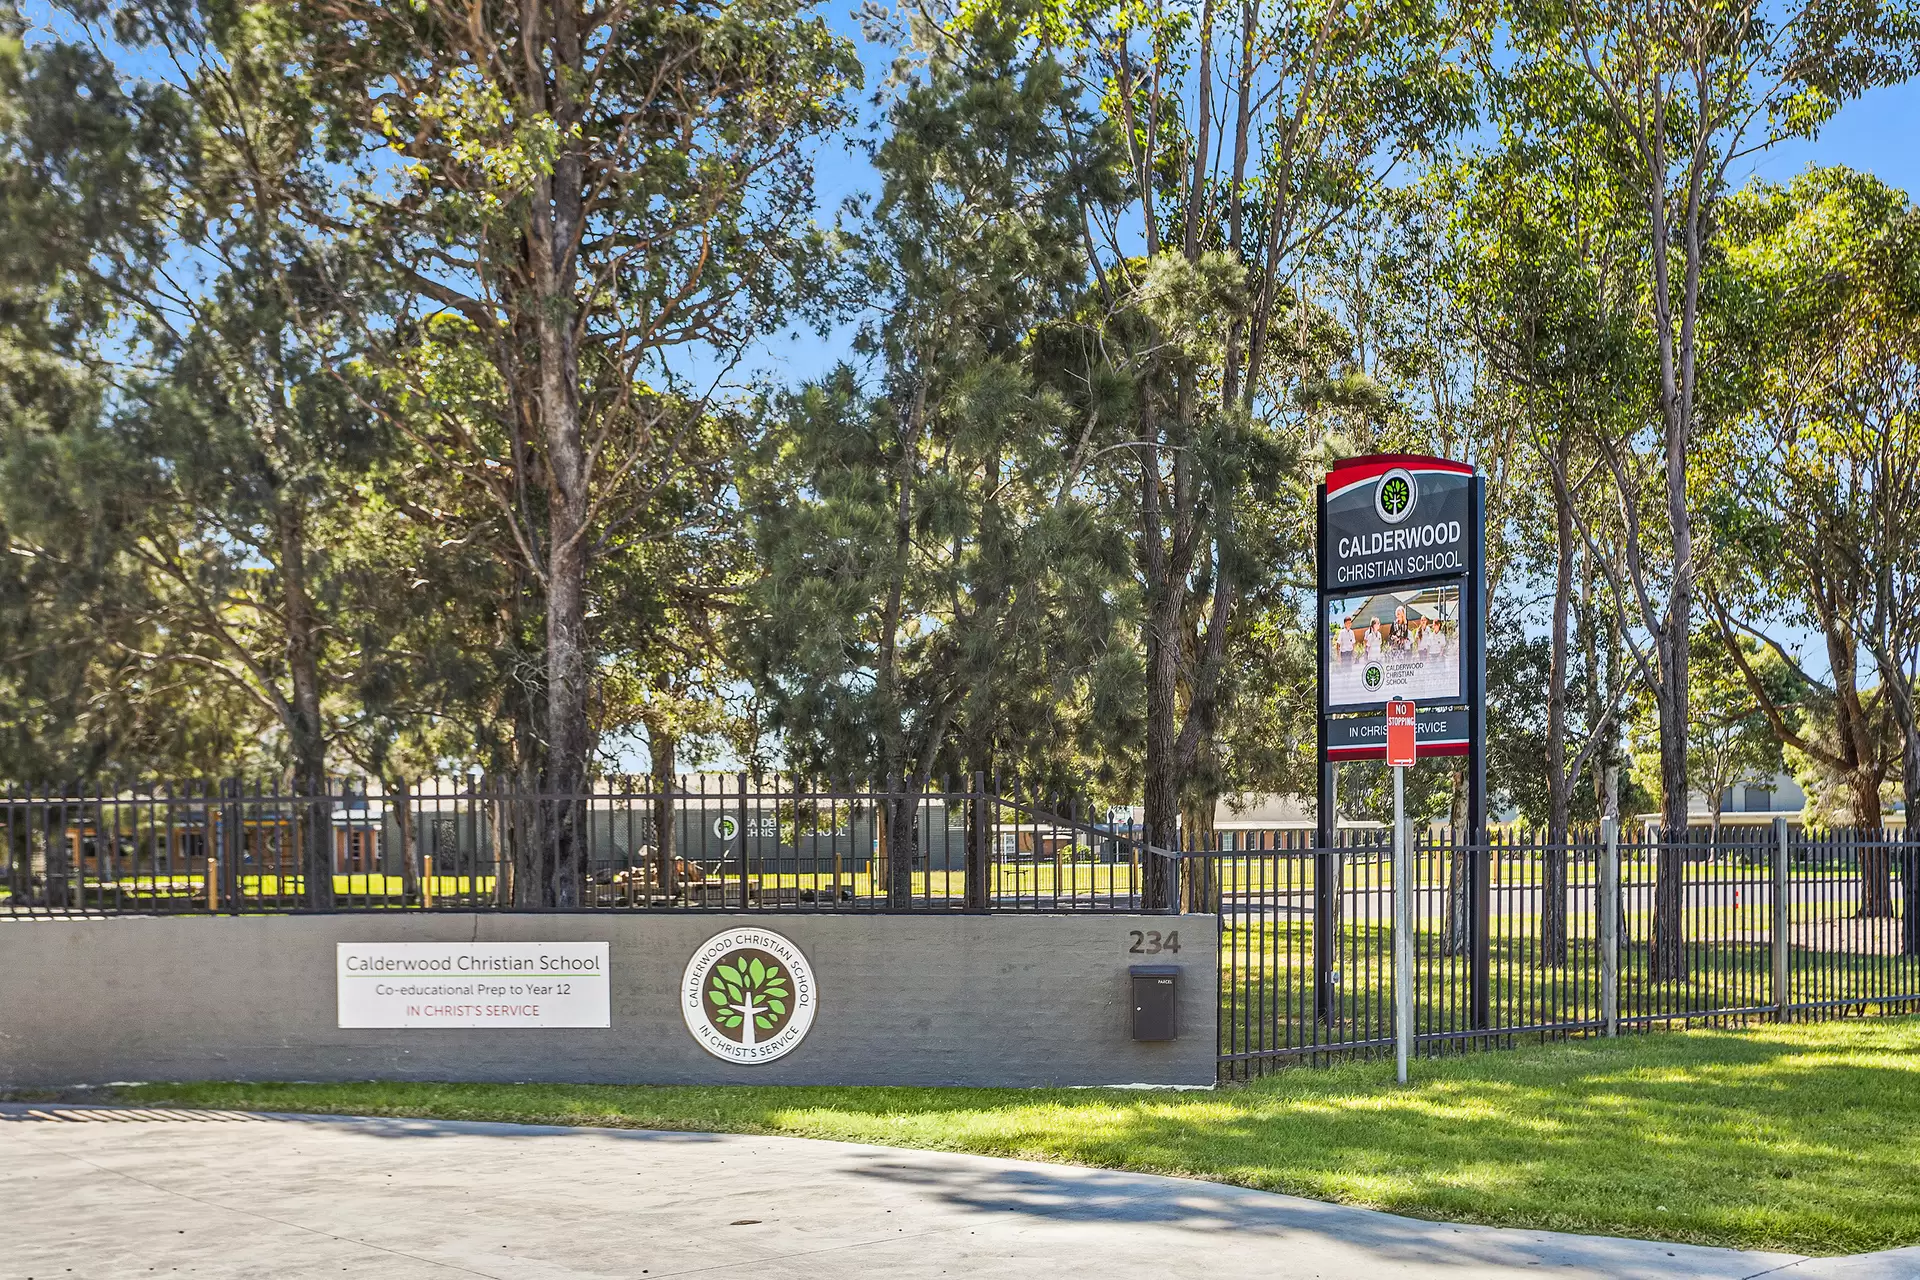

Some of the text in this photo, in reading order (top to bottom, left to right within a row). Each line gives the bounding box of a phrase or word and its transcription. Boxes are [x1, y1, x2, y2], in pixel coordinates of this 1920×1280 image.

[1338, 521, 1461, 559] CALDERWOOD
[1337, 551, 1463, 583] CHRISTIAN SCHOOL
[1385, 662, 1424, 672] CALDERWOOD
[1385, 670, 1414, 679] CHRISTIAN
[1385, 678, 1408, 686] SCHOOL
[1395, 704, 1407, 715] NO
[1388, 716, 1415, 727] STOPPING
[1349, 726, 1359, 738] IN
[1360, 724, 1388, 738] CHRIS
[1129, 930, 1182, 954] 234
[346, 955, 451, 971] Calderwood
[457, 955, 534, 971] Christian
[539, 955, 600, 971] School
[689, 935, 810, 1009] CALDERWOOD CHRISTIAN SCHOOL
[375, 984, 571, 999] Co-educational Prep to Year 12
[406, 1004, 540, 1017] IN CHRIST'S SERVICE
[698, 1024, 799, 1058] IN CHRIST'S SERVICE
